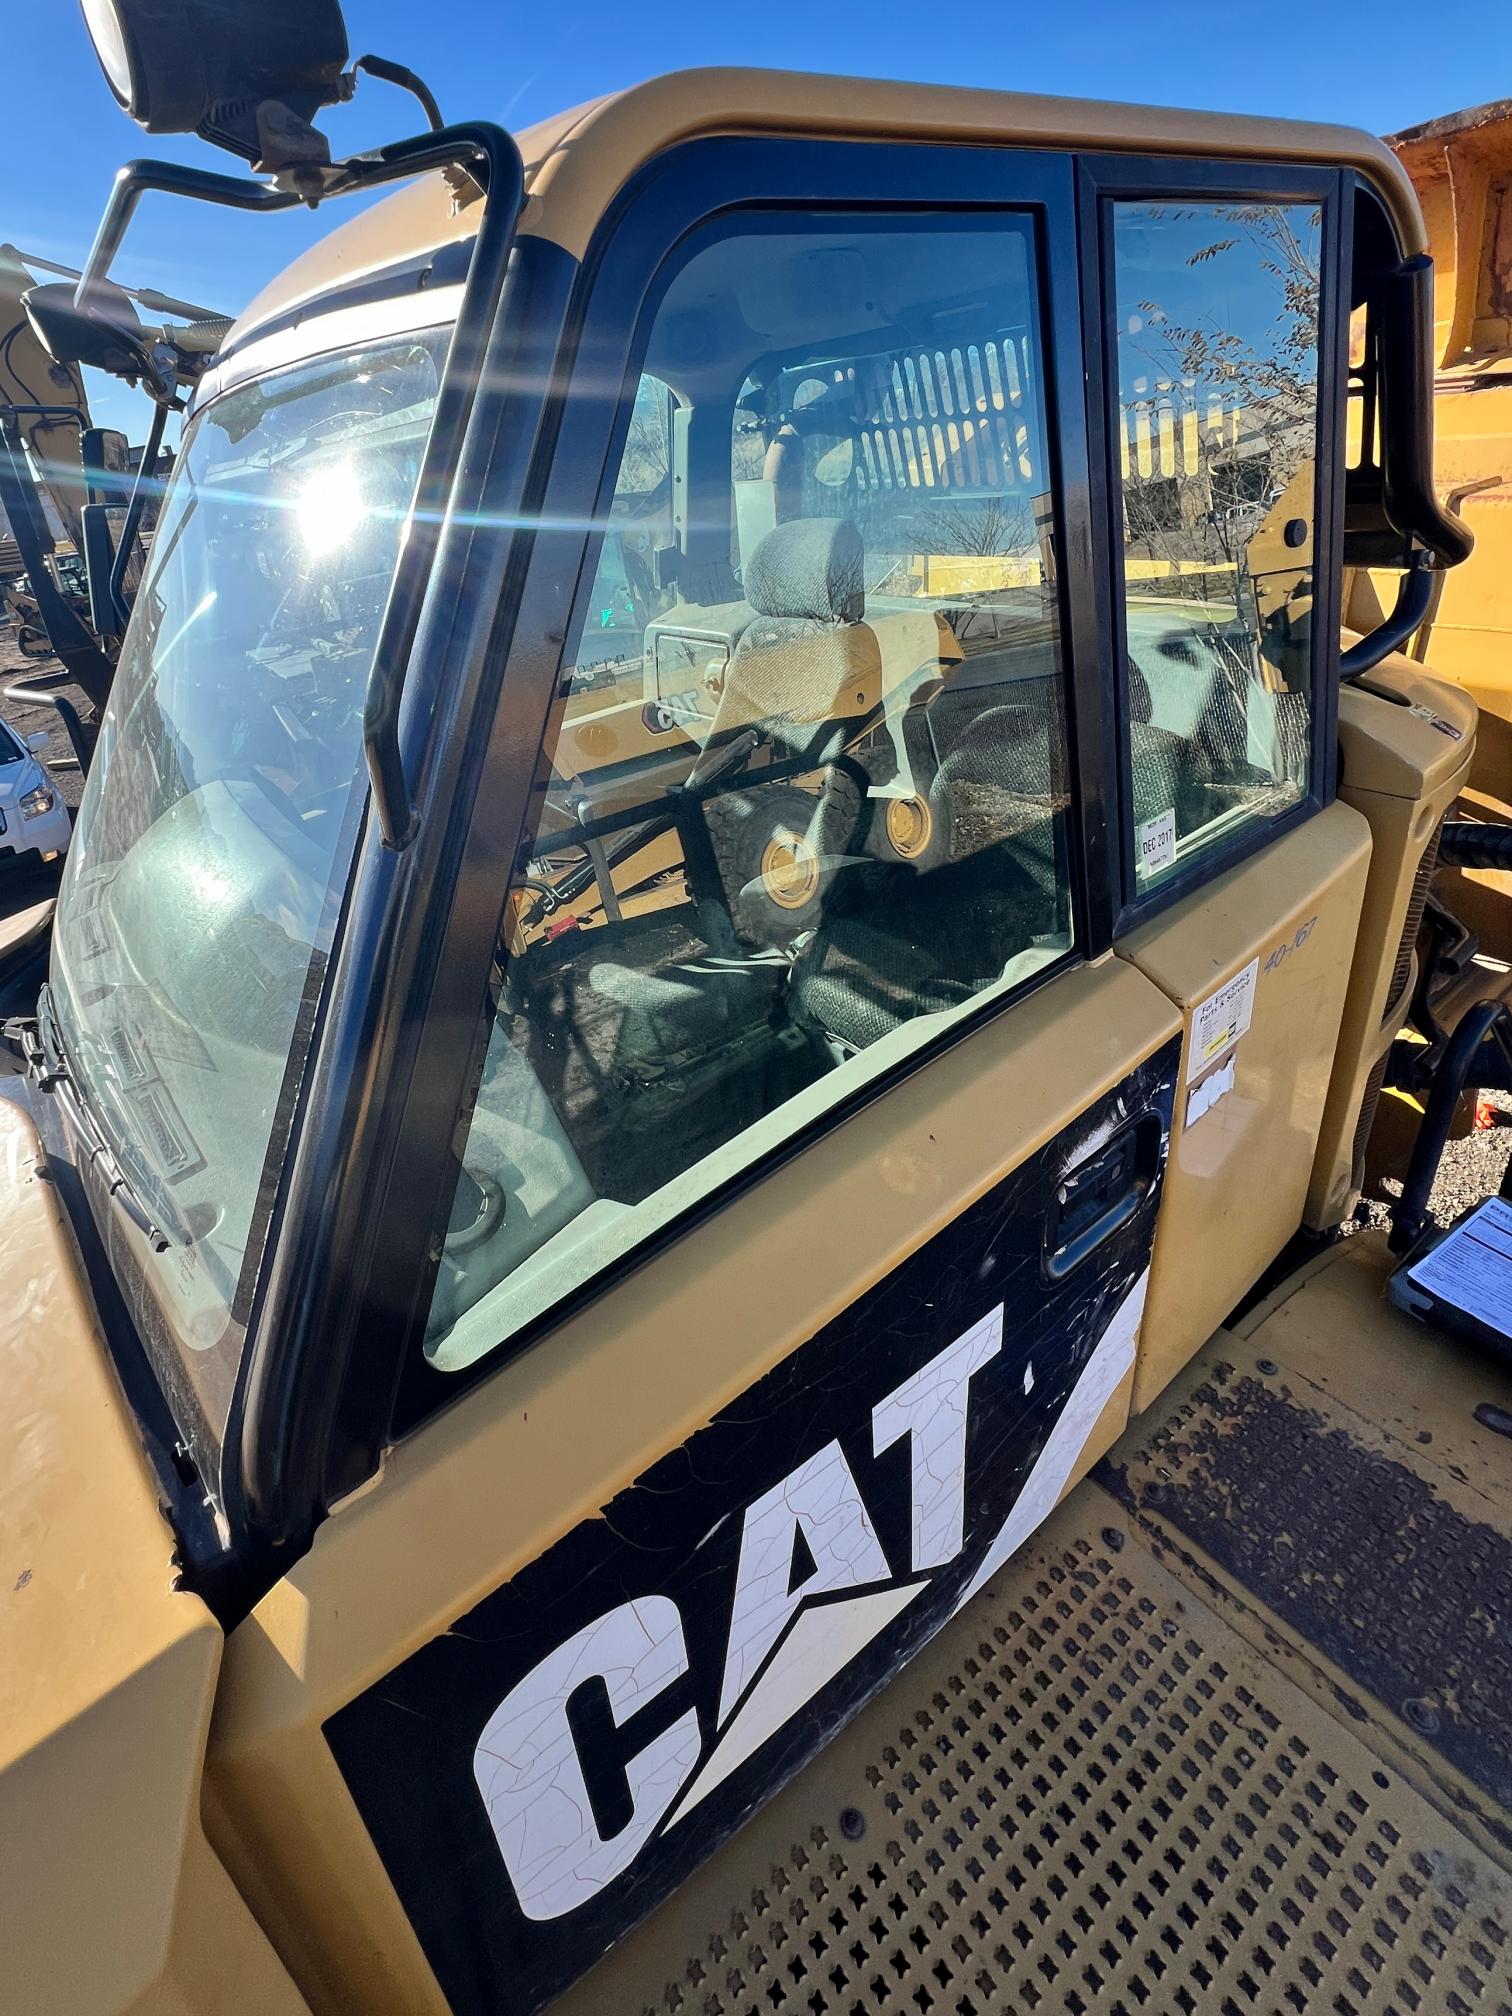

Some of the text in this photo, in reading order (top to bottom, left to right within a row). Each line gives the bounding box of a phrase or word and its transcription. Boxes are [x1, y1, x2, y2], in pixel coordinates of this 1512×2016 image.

[654, 690, 698, 729] CAT
[1143, 828, 1173, 854] DEC 2017
[1200, 1007, 1218, 1023] Parts
[1227, 980, 1250, 1002] Service
[1202, 1002, 1214, 1015] For
[1215, 972, 1250, 1004] Emergency
[474, 1302, 1003, 1920] CAT
